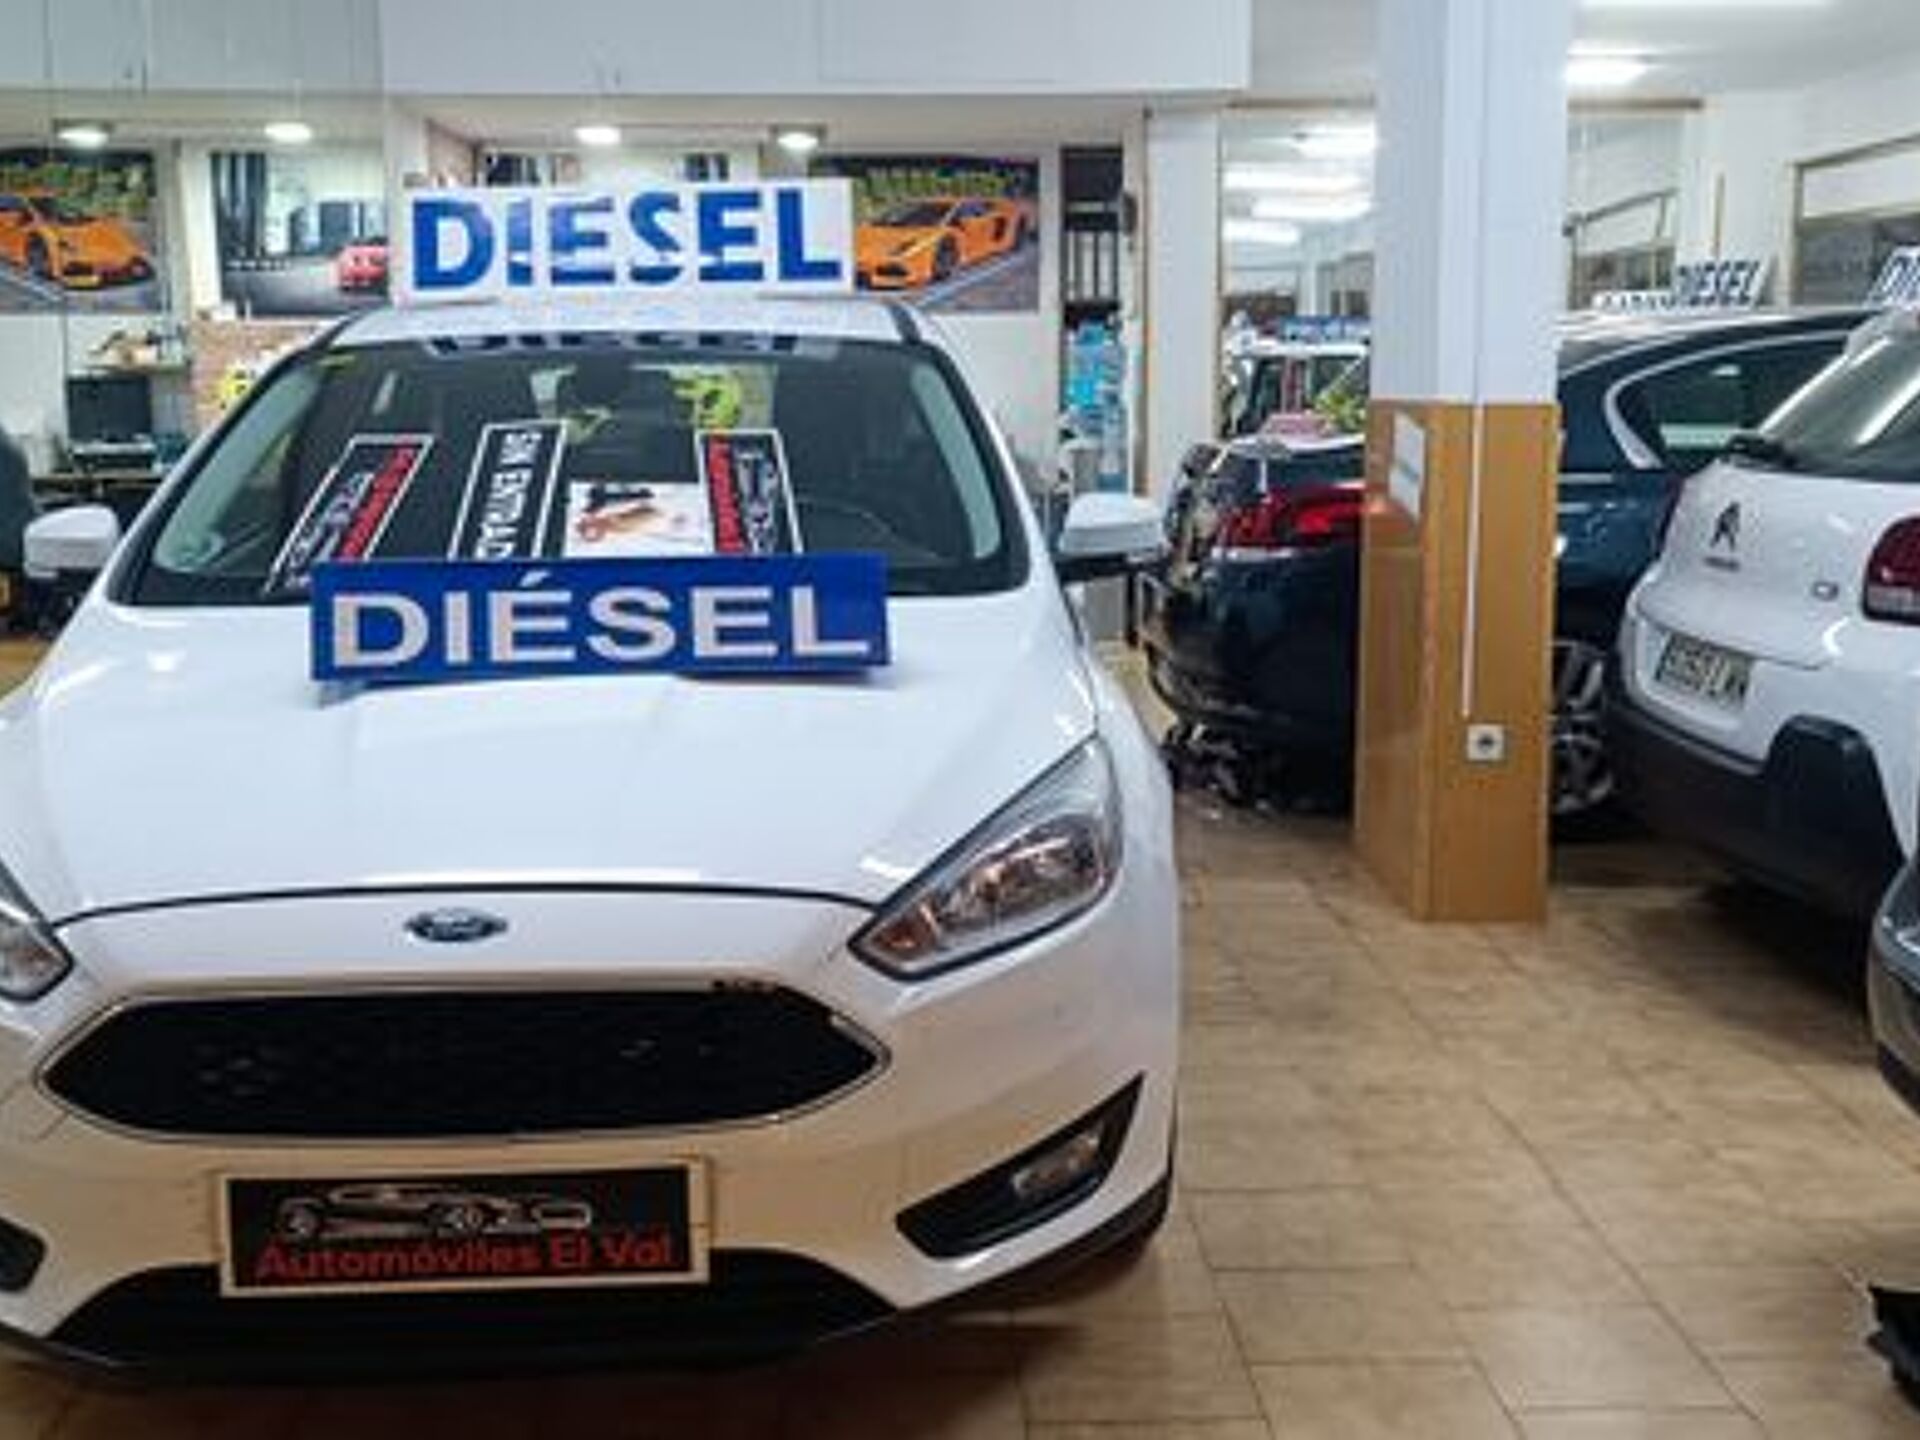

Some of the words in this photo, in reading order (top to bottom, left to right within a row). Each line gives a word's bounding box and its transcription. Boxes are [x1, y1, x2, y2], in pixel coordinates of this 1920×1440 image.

[412, 187, 843, 290] DIESEL
[501, 433, 543, 464] SIN
[333, 571, 869, 668] DIÉSEL
[254, 1236, 541, 1279] Automóviles
[551, 1229, 591, 1268] El
[601, 1229, 671, 1266] Val
